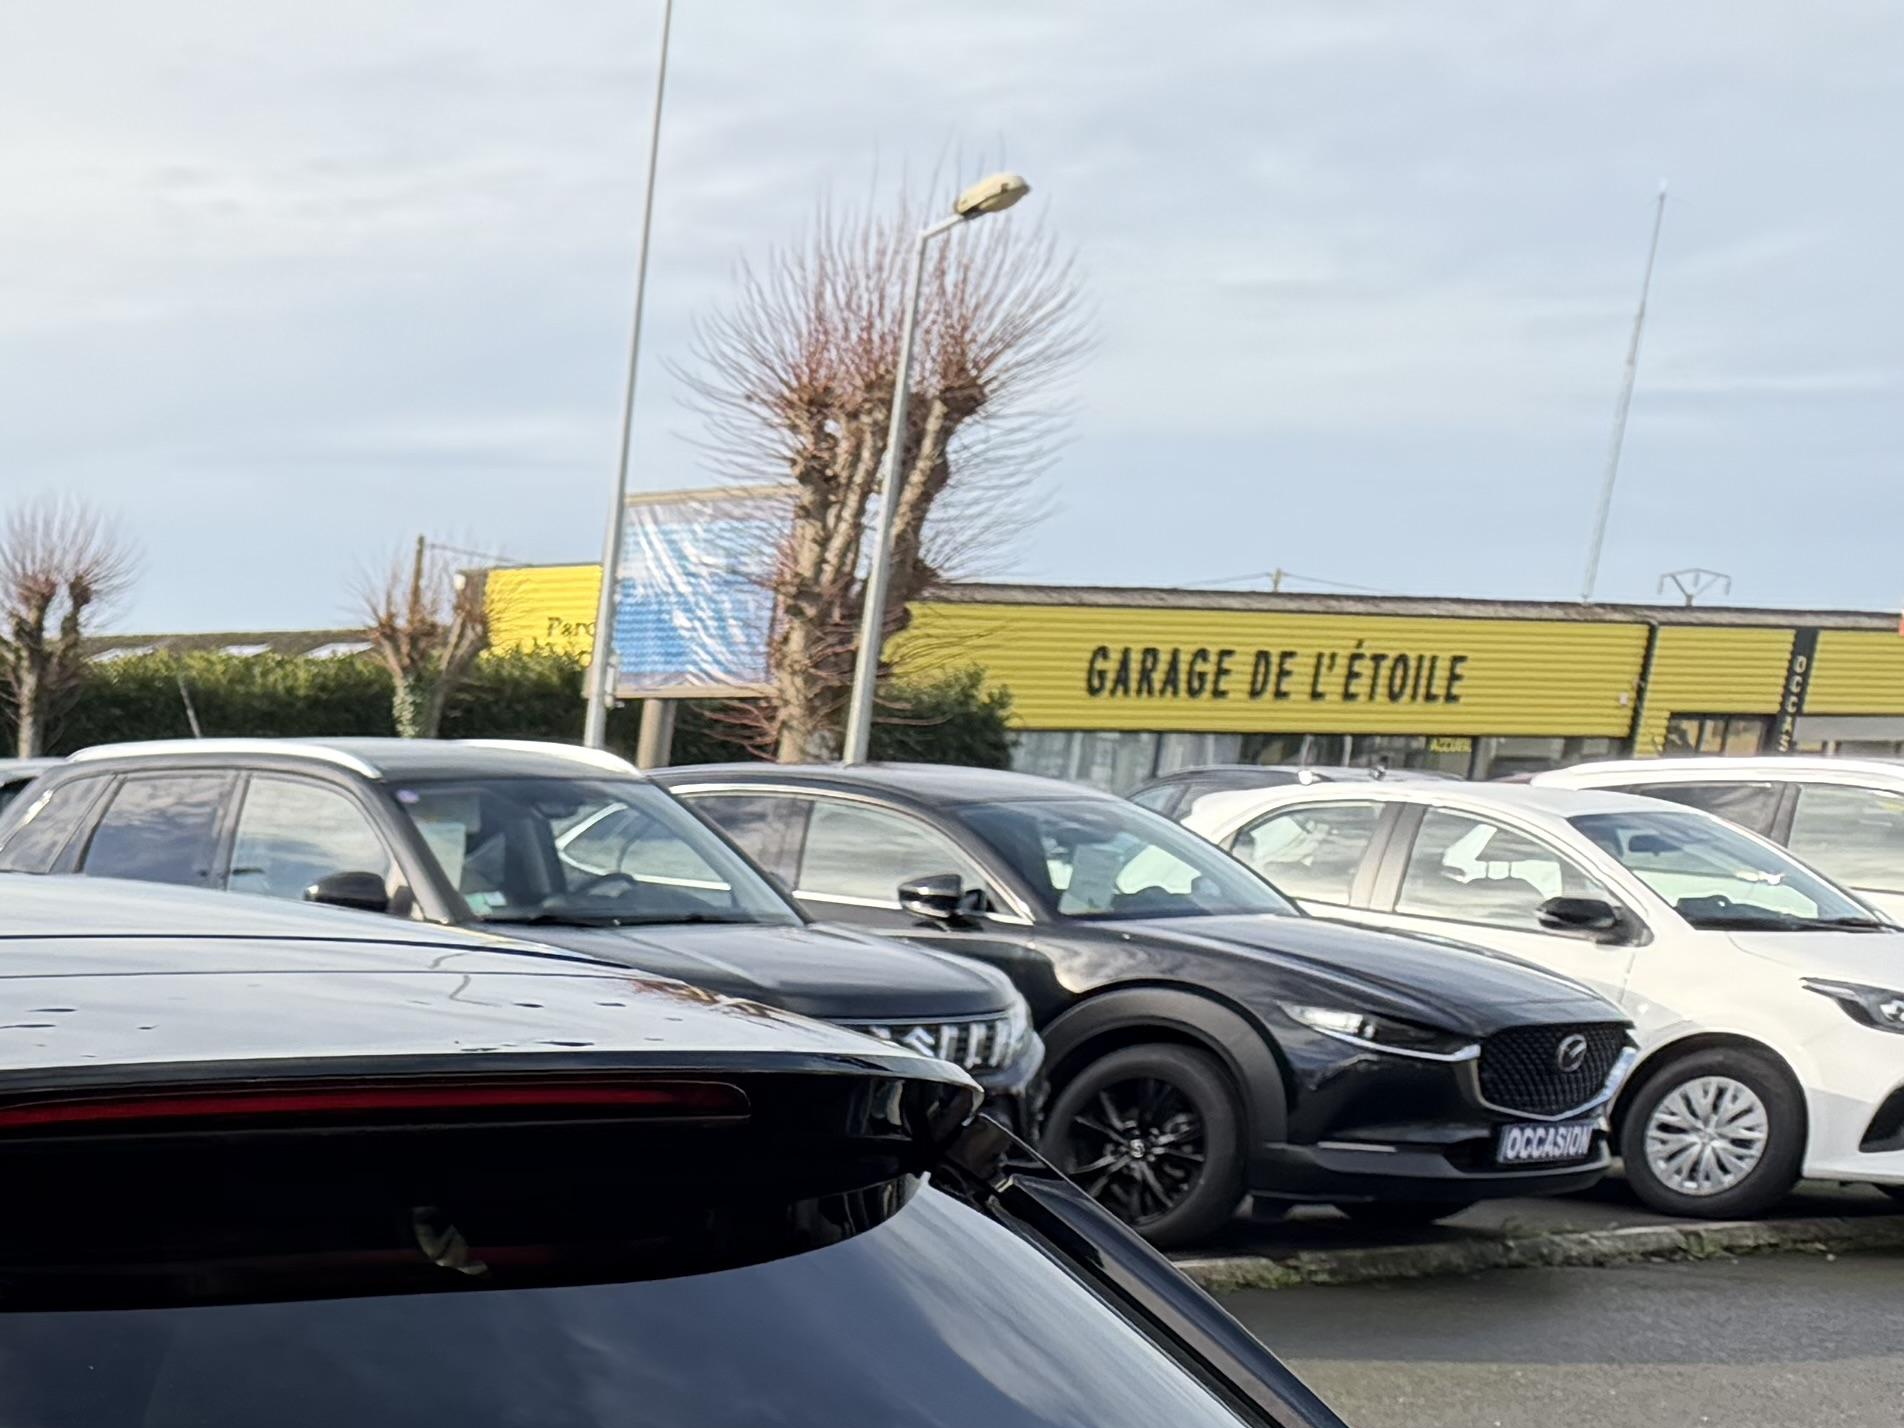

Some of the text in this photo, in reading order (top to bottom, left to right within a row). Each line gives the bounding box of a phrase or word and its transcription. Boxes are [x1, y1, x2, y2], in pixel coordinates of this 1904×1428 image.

[1087, 639, 1469, 704] GARAGE DE L'ÉTOILE
[1507, 1126, 1593, 1159] OCCASION
